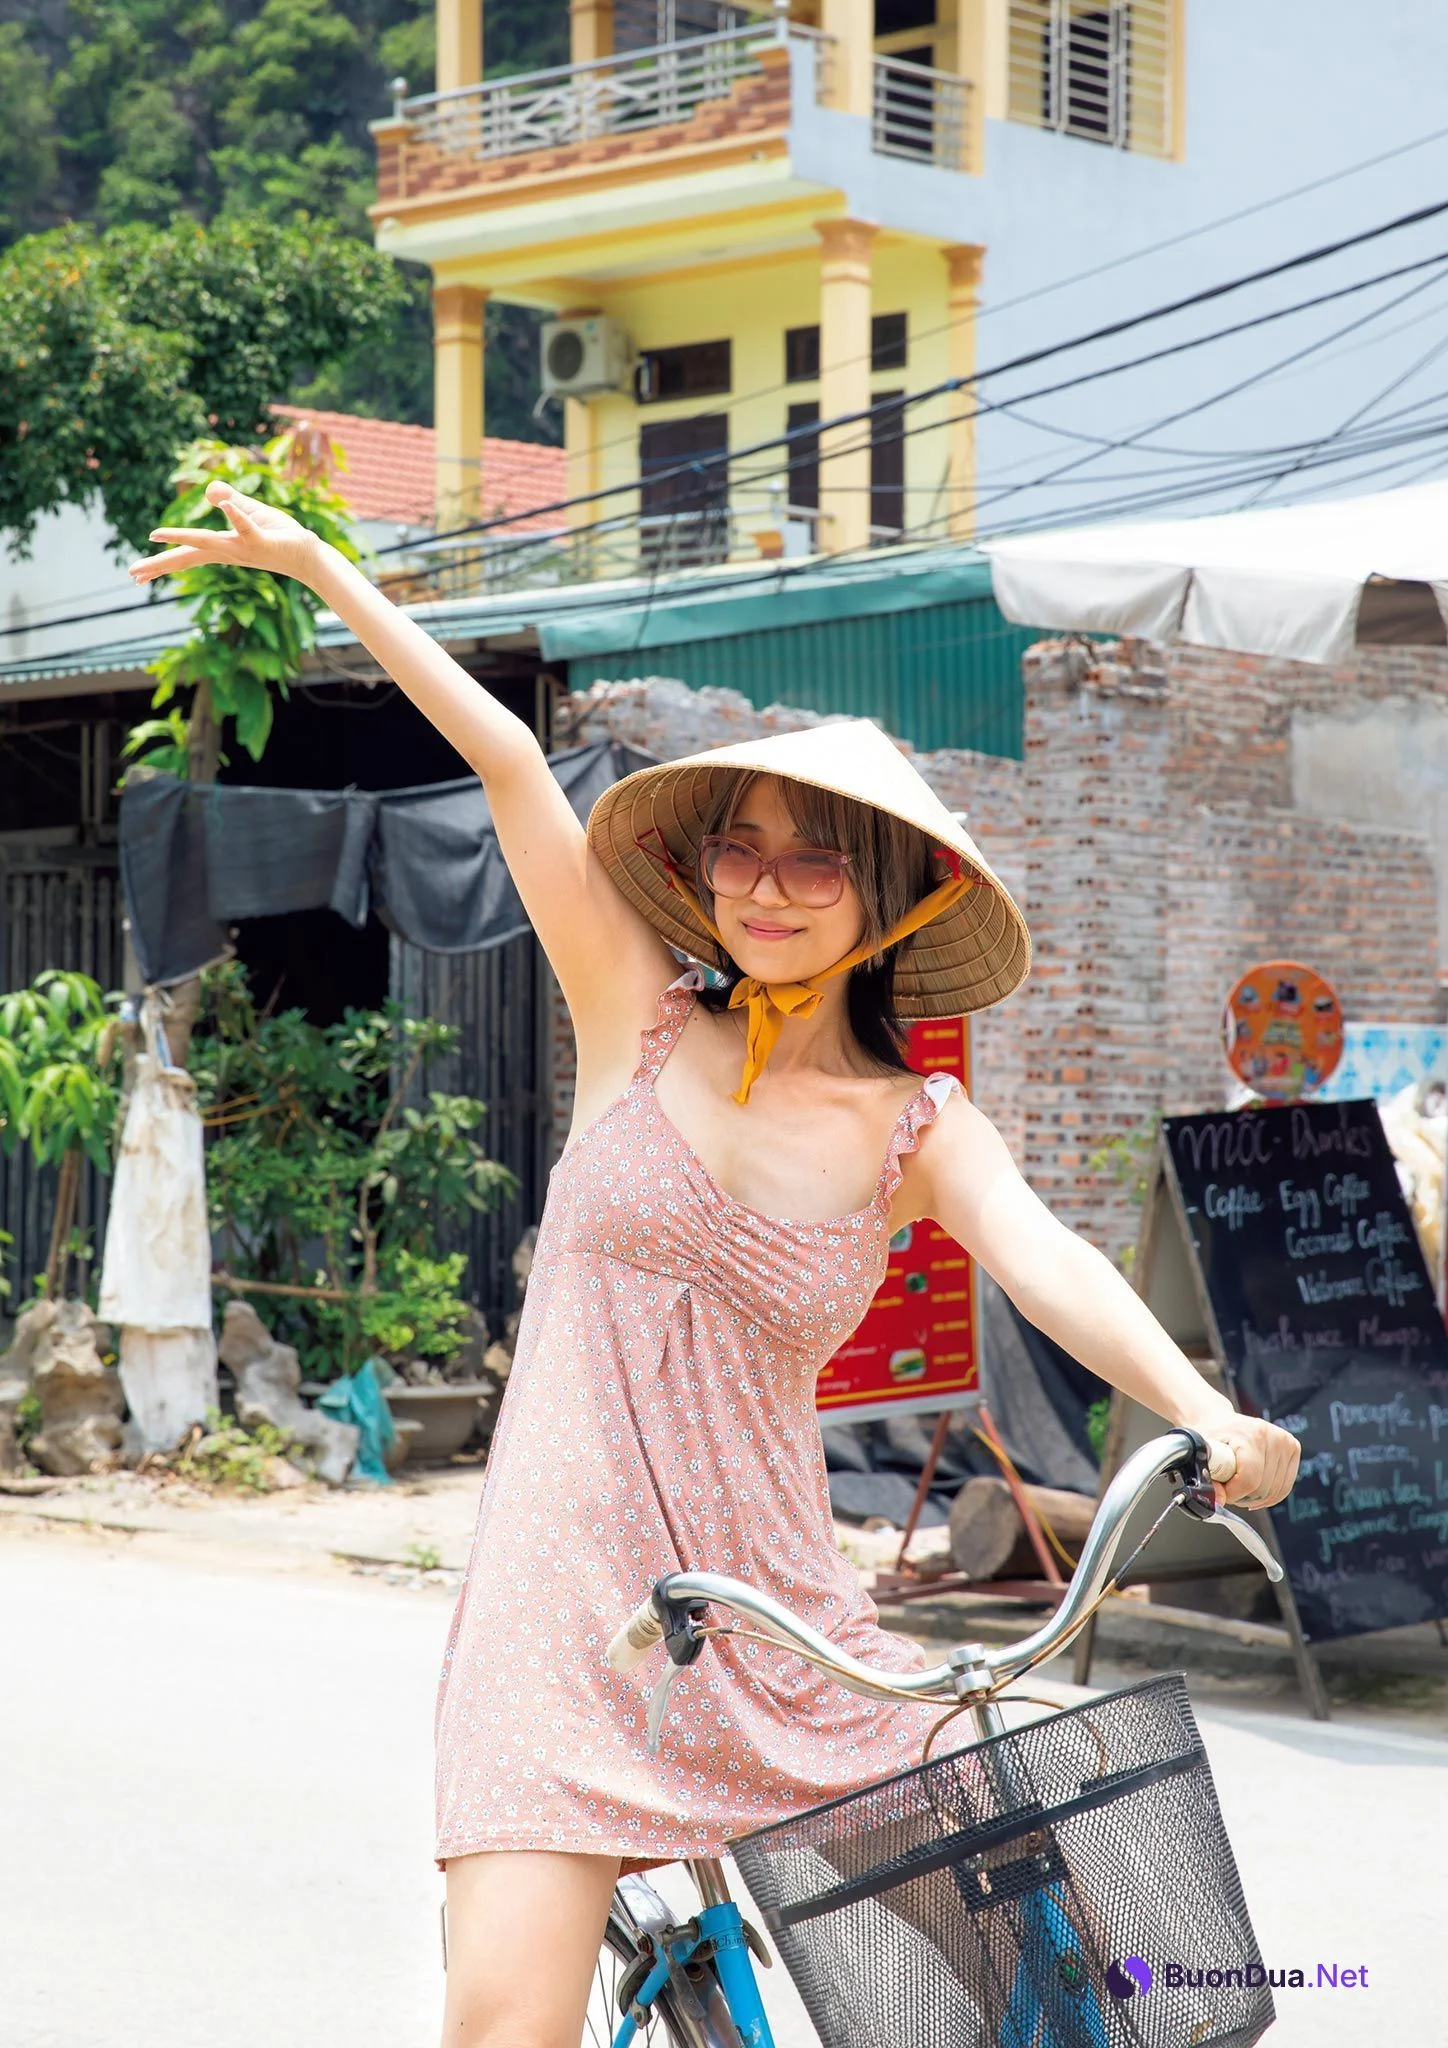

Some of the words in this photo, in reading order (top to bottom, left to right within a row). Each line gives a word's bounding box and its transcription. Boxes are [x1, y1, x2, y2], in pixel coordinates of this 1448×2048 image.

[1205, 1184, 1264, 1230] Coffee
[1279, 1180, 1320, 1229] Egg
[1323, 1173, 1370, 1216] Coffee
